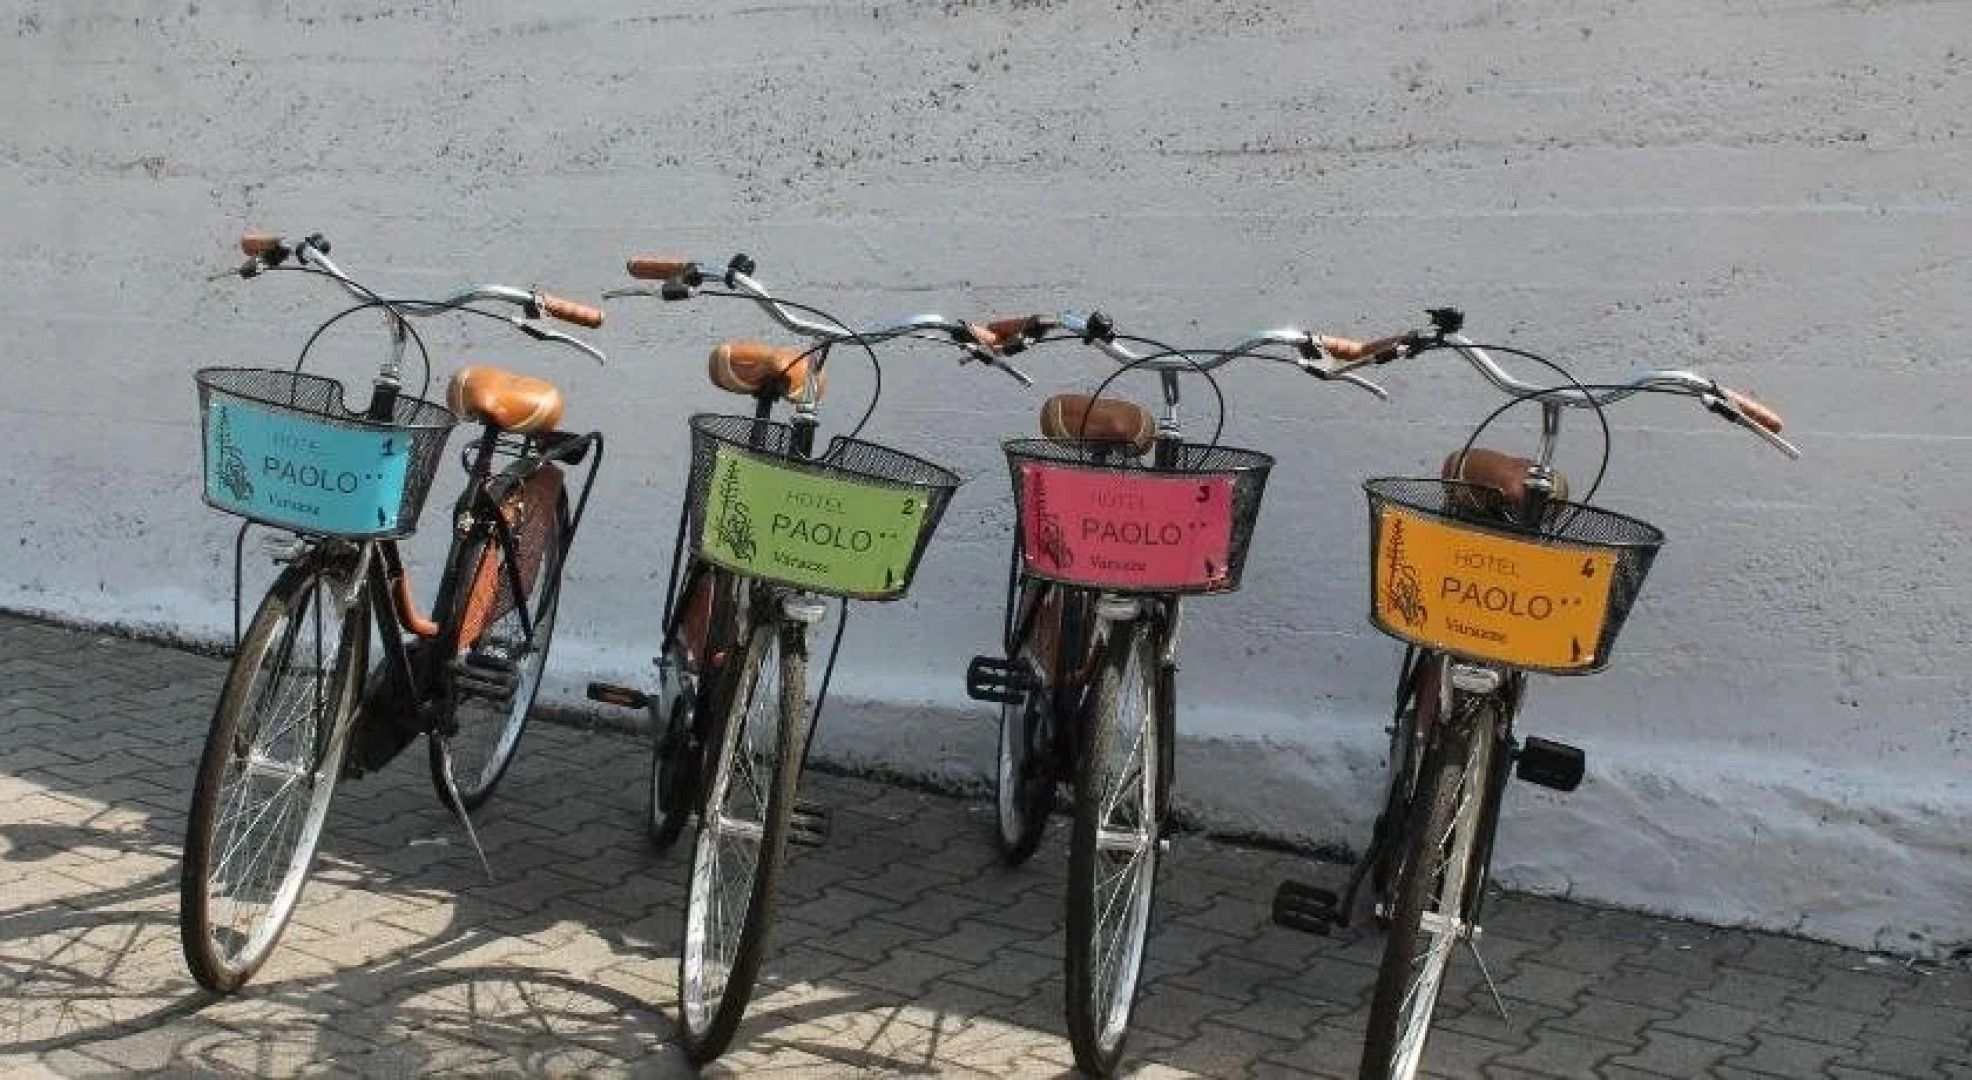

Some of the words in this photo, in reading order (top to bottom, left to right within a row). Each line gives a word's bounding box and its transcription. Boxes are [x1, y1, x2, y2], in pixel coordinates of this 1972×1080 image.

[381, 438, 394, 456] 1
[263, 455, 358, 494] PAOLO
[784, 490, 846, 515] HOTEL
[1196, 485, 1211, 503] 3
[901, 498, 914, 516] 2
[771, 513, 873, 553] PAOLO
[1081, 518, 1182, 546] PAOLO
[1453, 552, 1520, 578] HOTEL
[1580, 558, 1595, 578] 4
[1440, 576, 1553, 621] PAOLO
